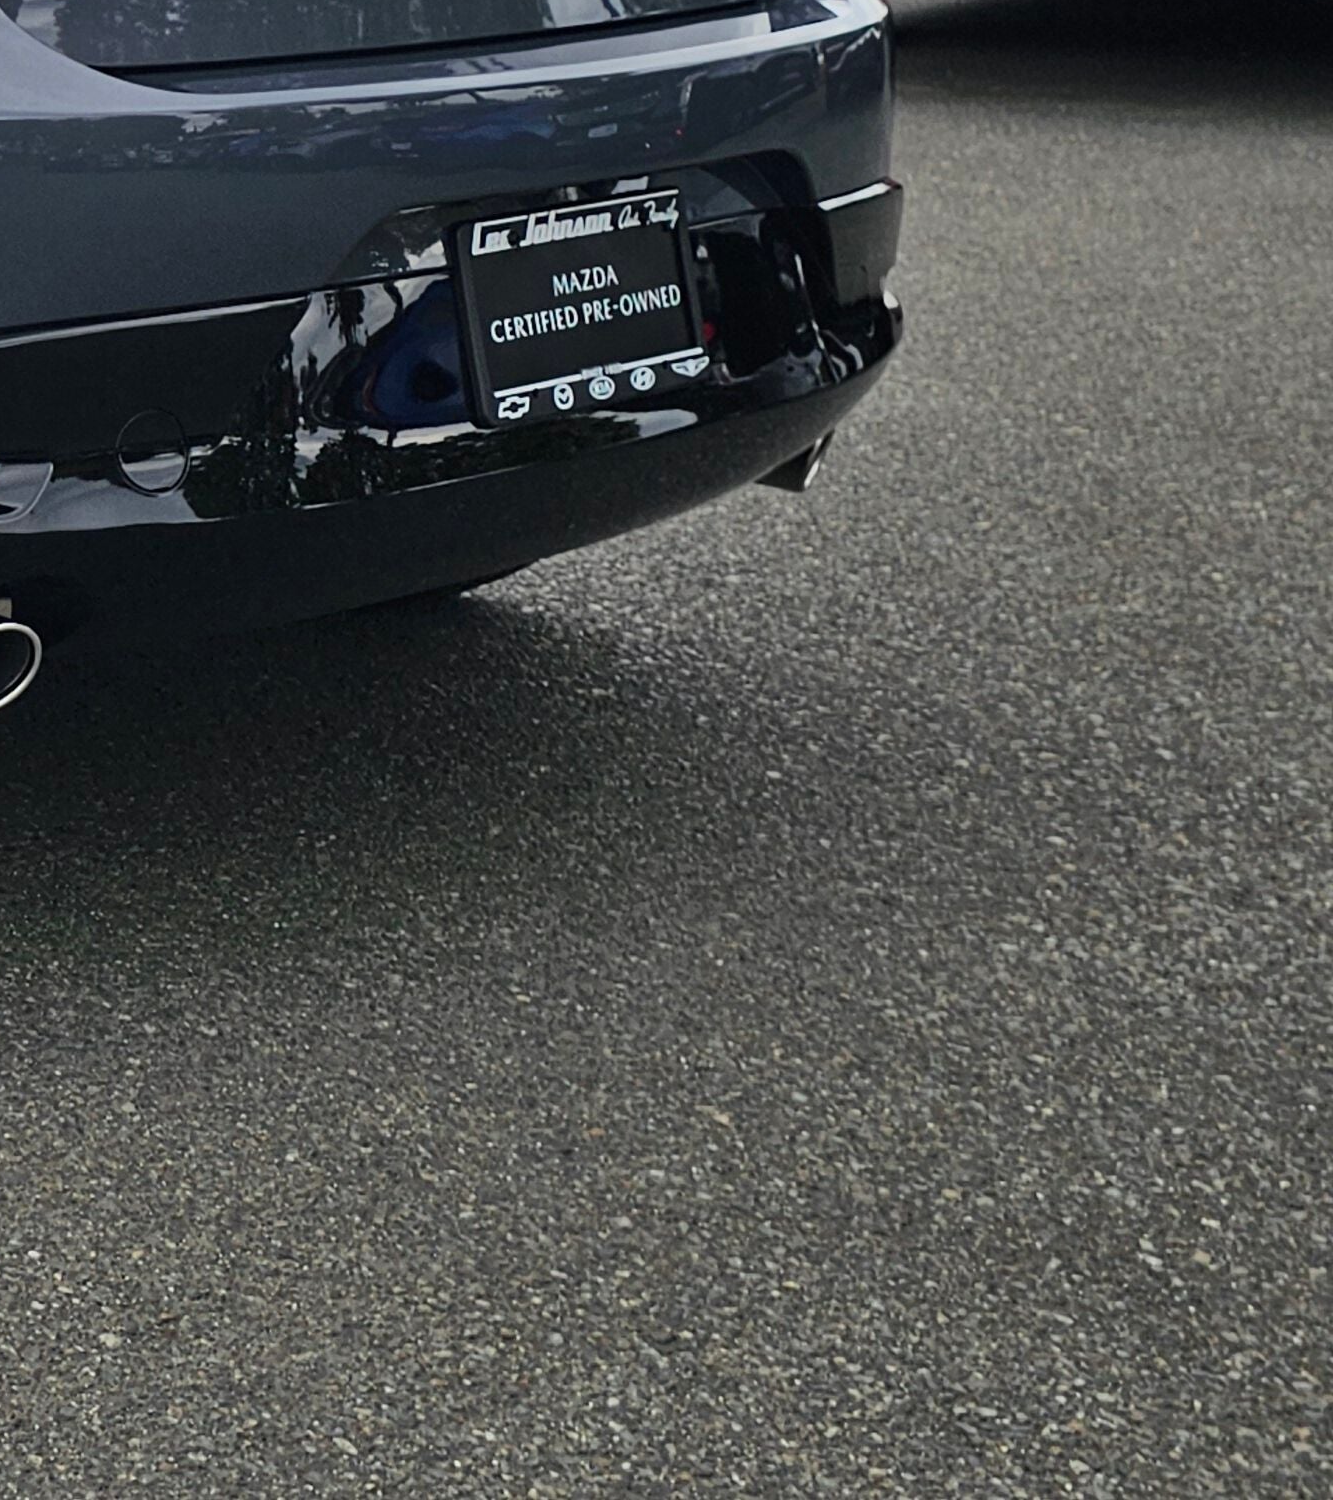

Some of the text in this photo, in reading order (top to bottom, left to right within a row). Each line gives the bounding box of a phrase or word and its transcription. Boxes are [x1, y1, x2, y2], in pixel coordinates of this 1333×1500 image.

[519, 211, 614, 248] Johnson
[551, 264, 620, 297] MAZDA
[489, 283, 681, 344] CERTIFIED PRE-OWNED
